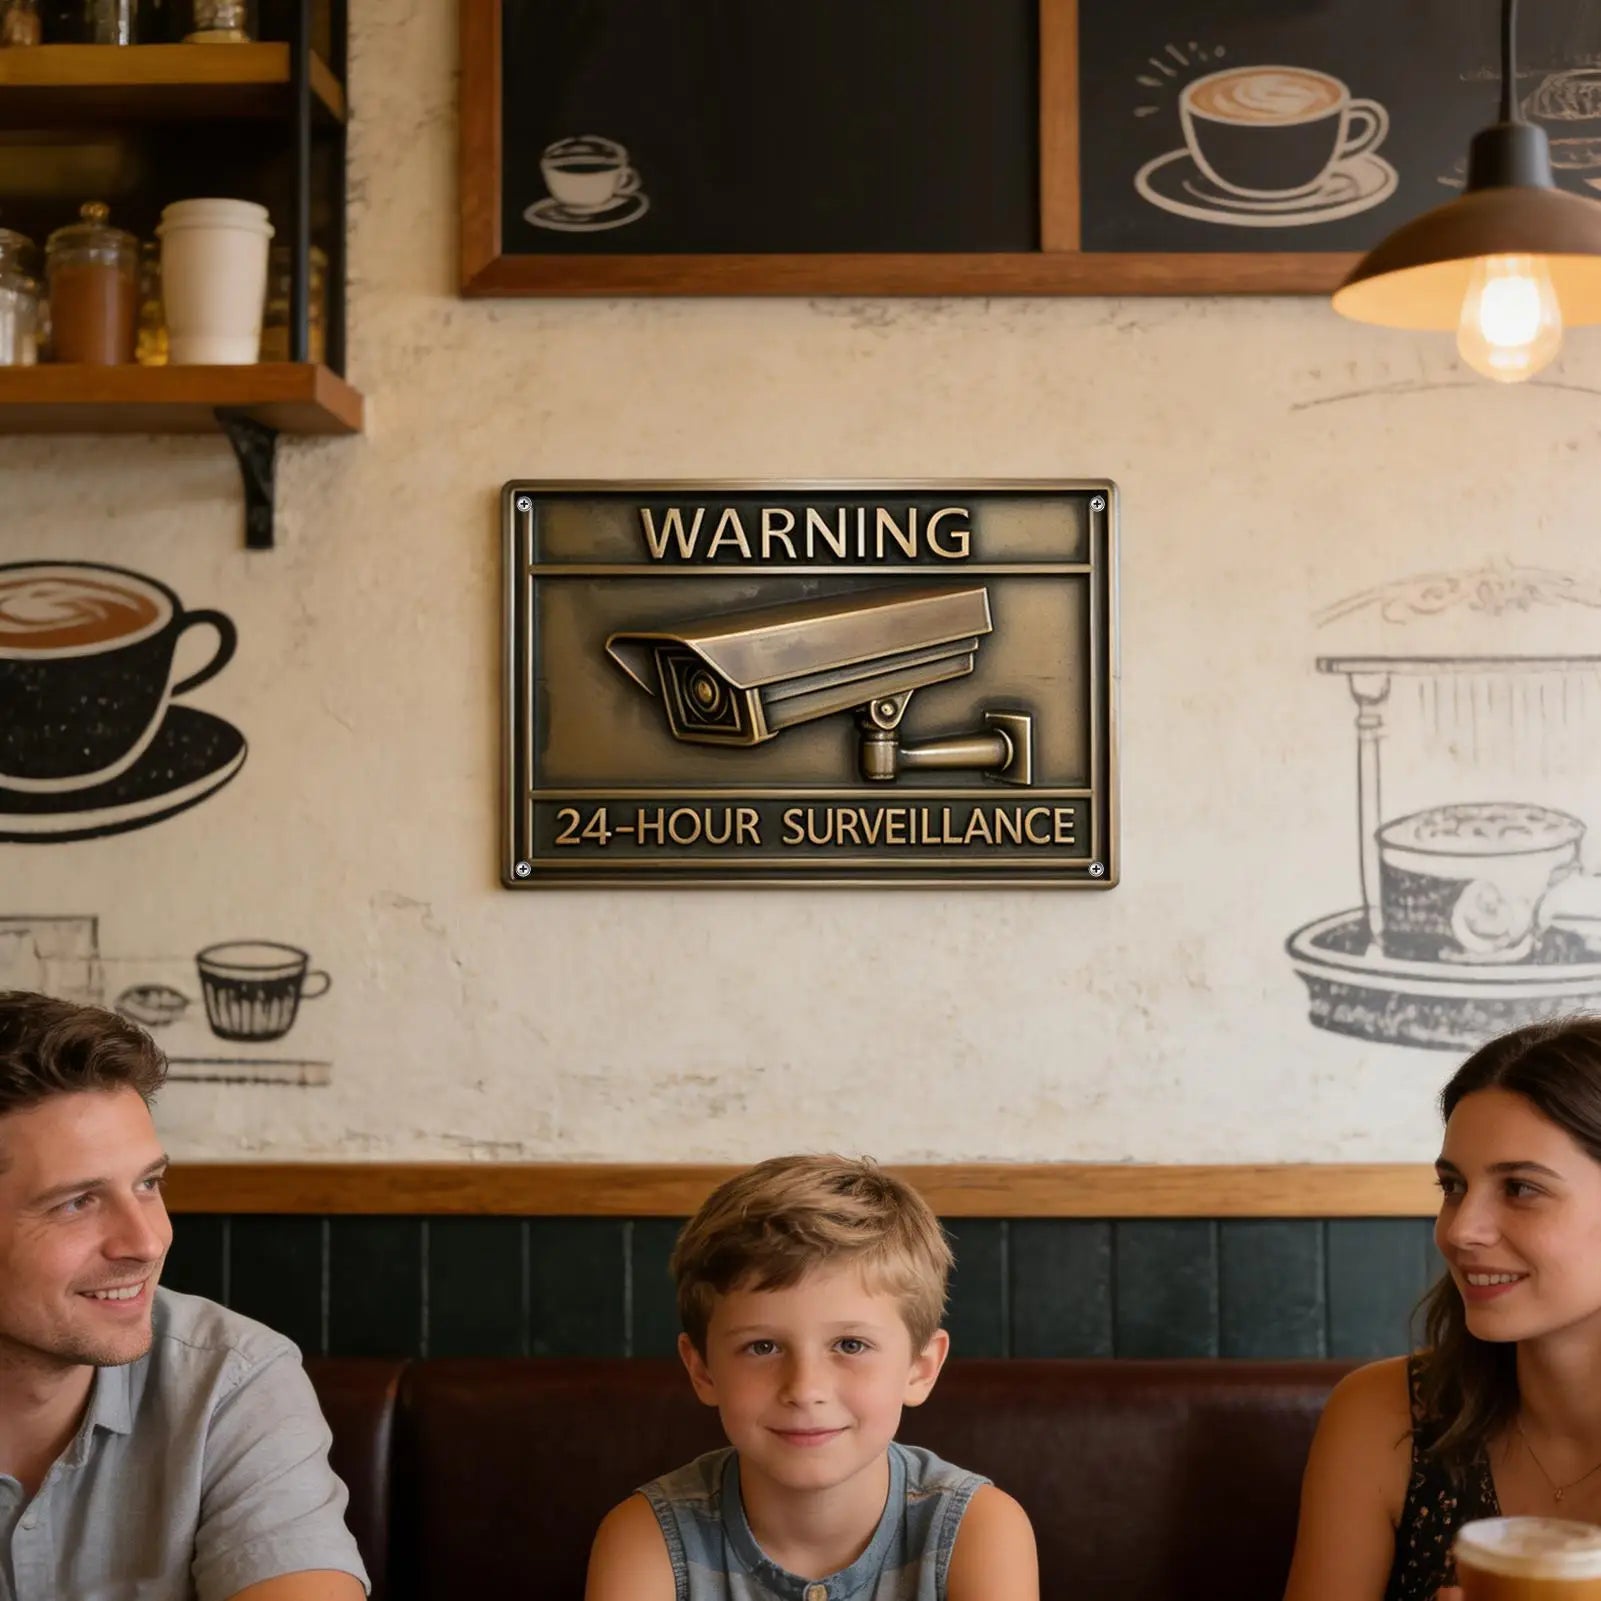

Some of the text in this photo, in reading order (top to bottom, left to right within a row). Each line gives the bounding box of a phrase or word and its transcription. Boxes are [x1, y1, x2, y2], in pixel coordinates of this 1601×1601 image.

[640, 507, 971, 559] WARNING
[555, 807, 1076, 847] 24-HOUR SURVEILLANCE
